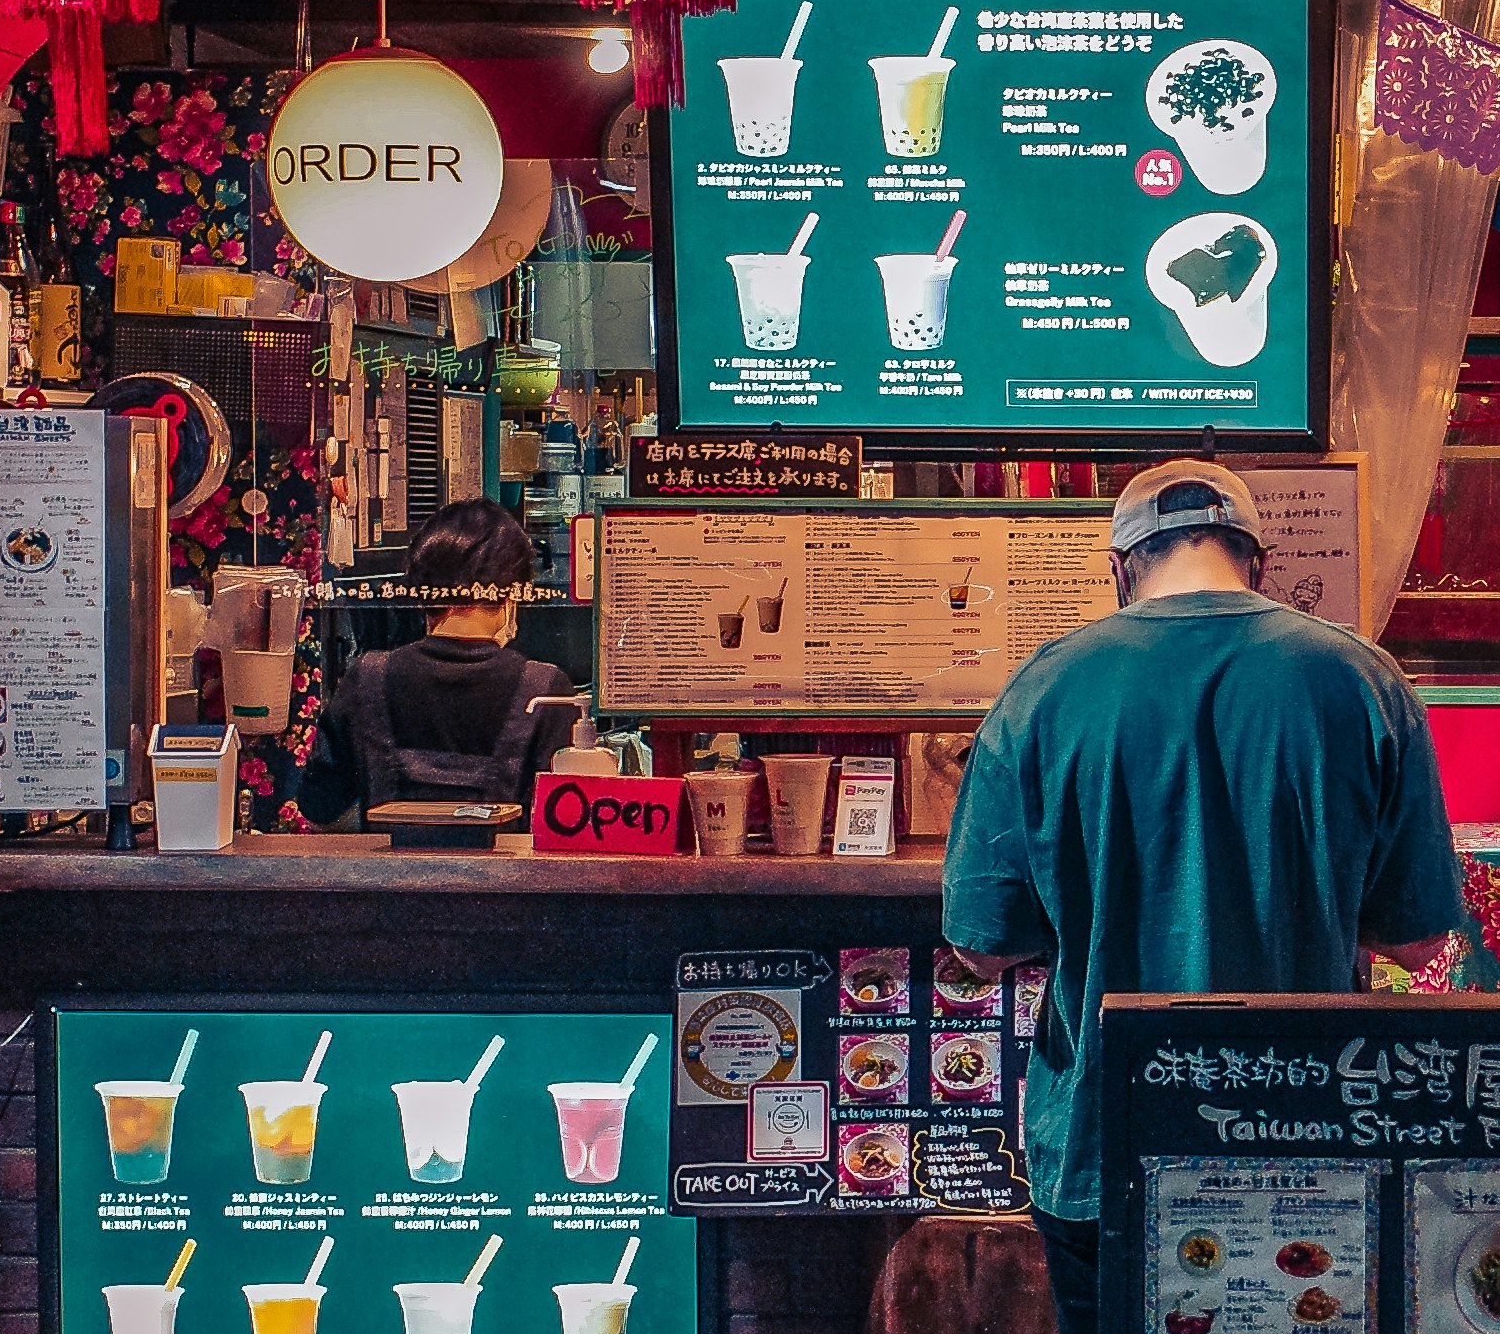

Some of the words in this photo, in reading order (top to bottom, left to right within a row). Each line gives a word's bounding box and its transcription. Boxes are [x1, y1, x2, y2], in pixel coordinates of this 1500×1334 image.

[1002, 88, 1113, 101] タピオカミルクティー
[1058, 122, 1080, 134] Tea
[273, 143, 462, 185] ORDER
[776, 788, 789, 808] L
[543, 782, 670, 841] Open
[707, 802, 726, 819] M
[1198, 1104, 1343, 1145] Taiwan
[1351, 1108, 1463, 1146] Street
[680, 1173, 722, 1196] TAKE
[725, 1173, 757, 1196] OUT
